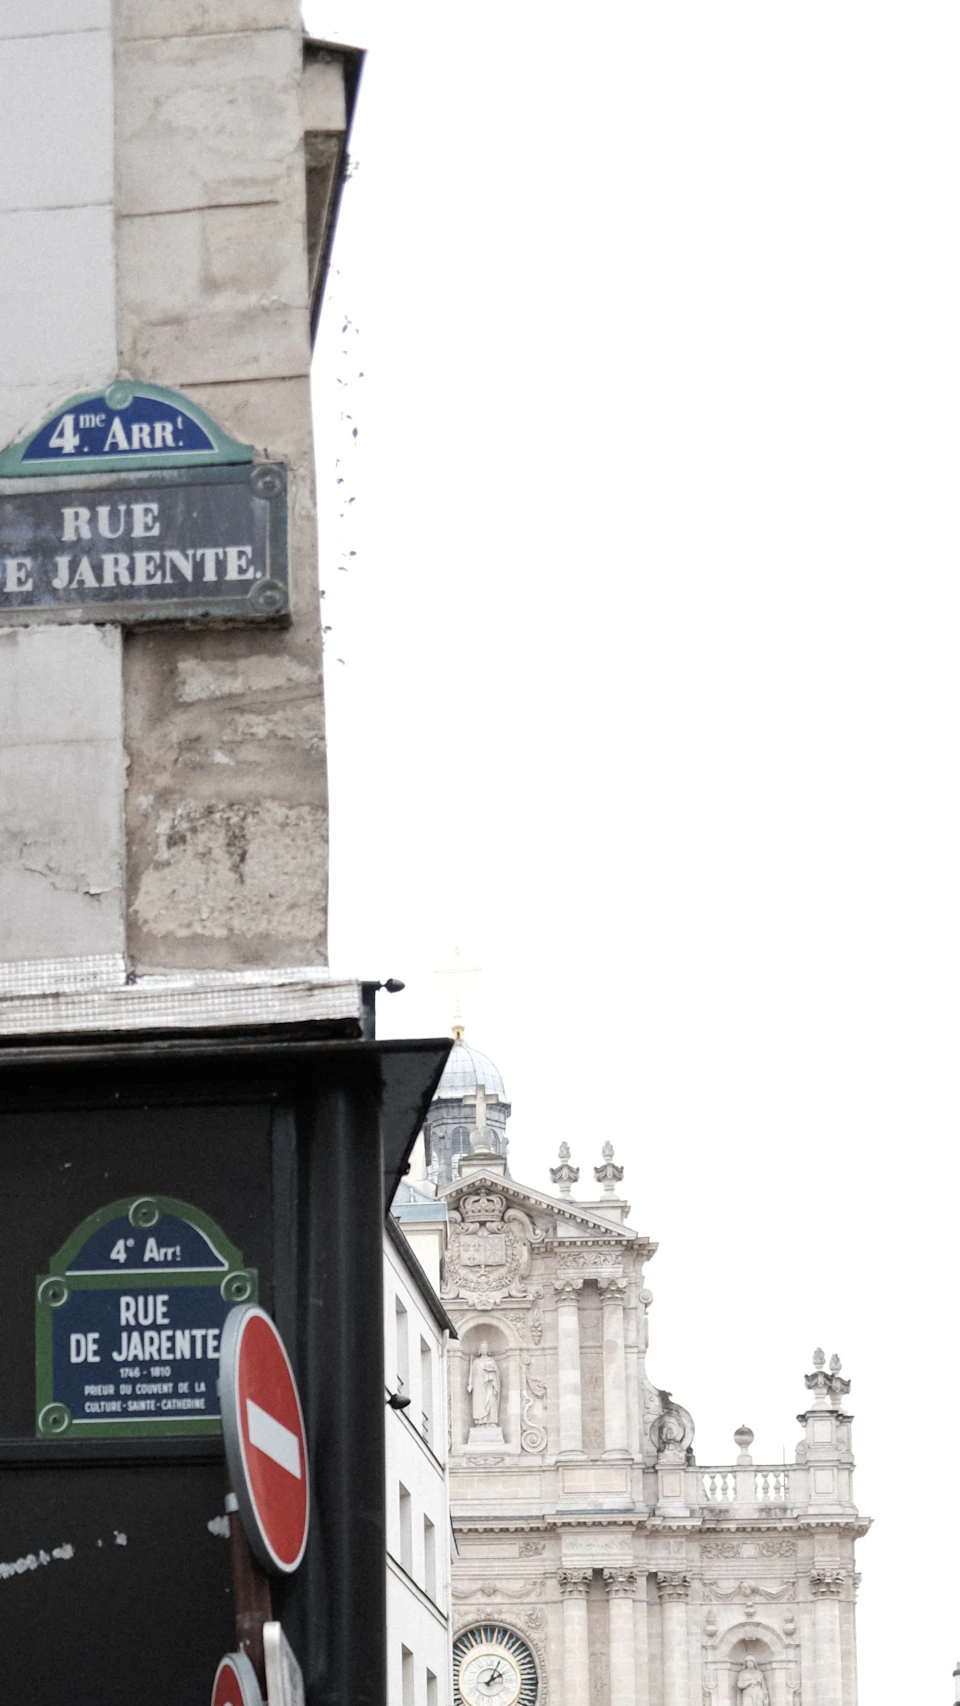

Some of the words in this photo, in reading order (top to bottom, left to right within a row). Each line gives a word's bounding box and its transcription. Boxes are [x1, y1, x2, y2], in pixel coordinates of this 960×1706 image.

[60, 502, 161, 542] RUE
[51, 545, 263, 590] JARENTE.
[119, 1294, 170, 1326] RUE
[69, 1332, 101, 1364] DE
[111, 1328, 220, 1362] JARENTE
[84, 1383, 115, 1396] PRIEUR
[119, 1383, 133, 1396] DU
[135, 1382, 174, 1395] COUVENT
[177, 1381, 189, 1394] DE
[194, 1381, 206, 1393] LA
[149, 1365, 172, 1378] 1810
